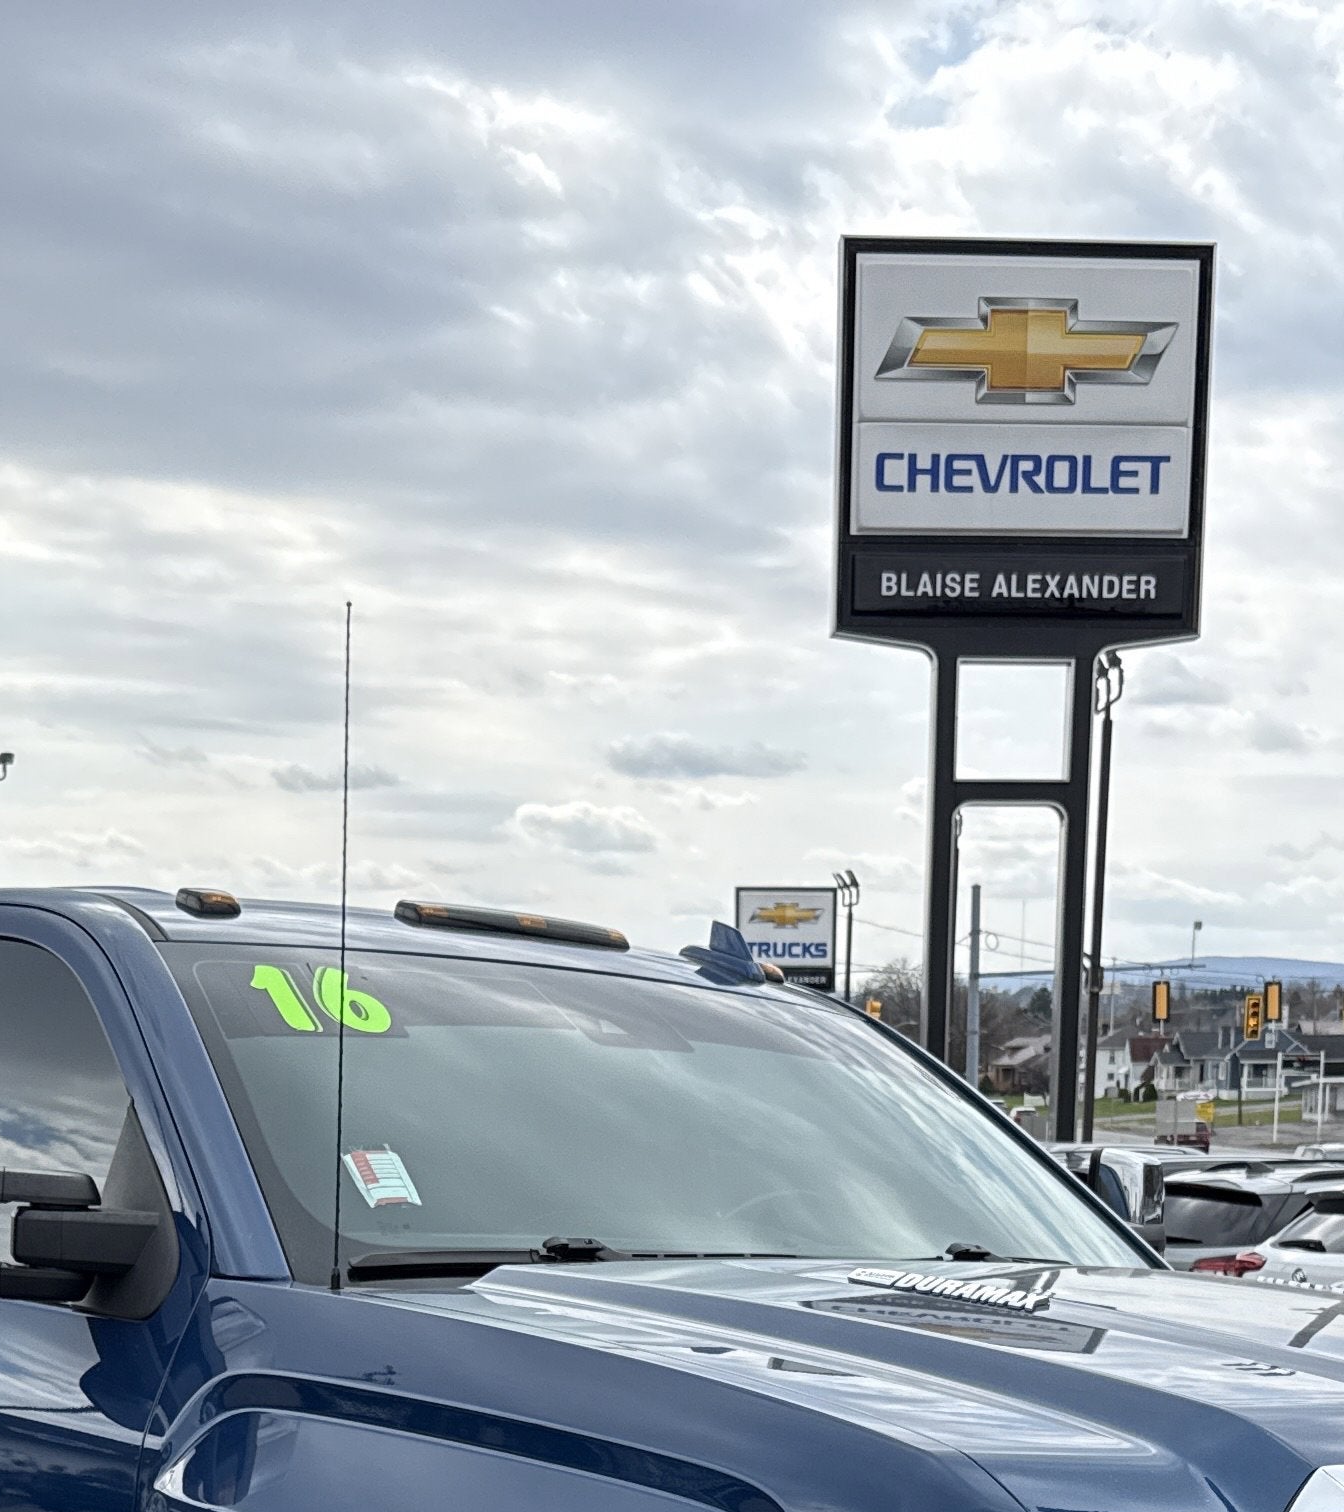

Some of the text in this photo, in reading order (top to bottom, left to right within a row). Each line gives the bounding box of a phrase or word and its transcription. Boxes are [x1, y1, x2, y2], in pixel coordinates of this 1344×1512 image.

[875, 452, 1171, 495] CHEVROLET
[880, 570, 1157, 600] BLAISE ALEXANDER
[747, 942, 828, 959] TRUCKS
[250, 965, 392, 1033] 16
[894, 1272, 1052, 1313] DURAMAX
